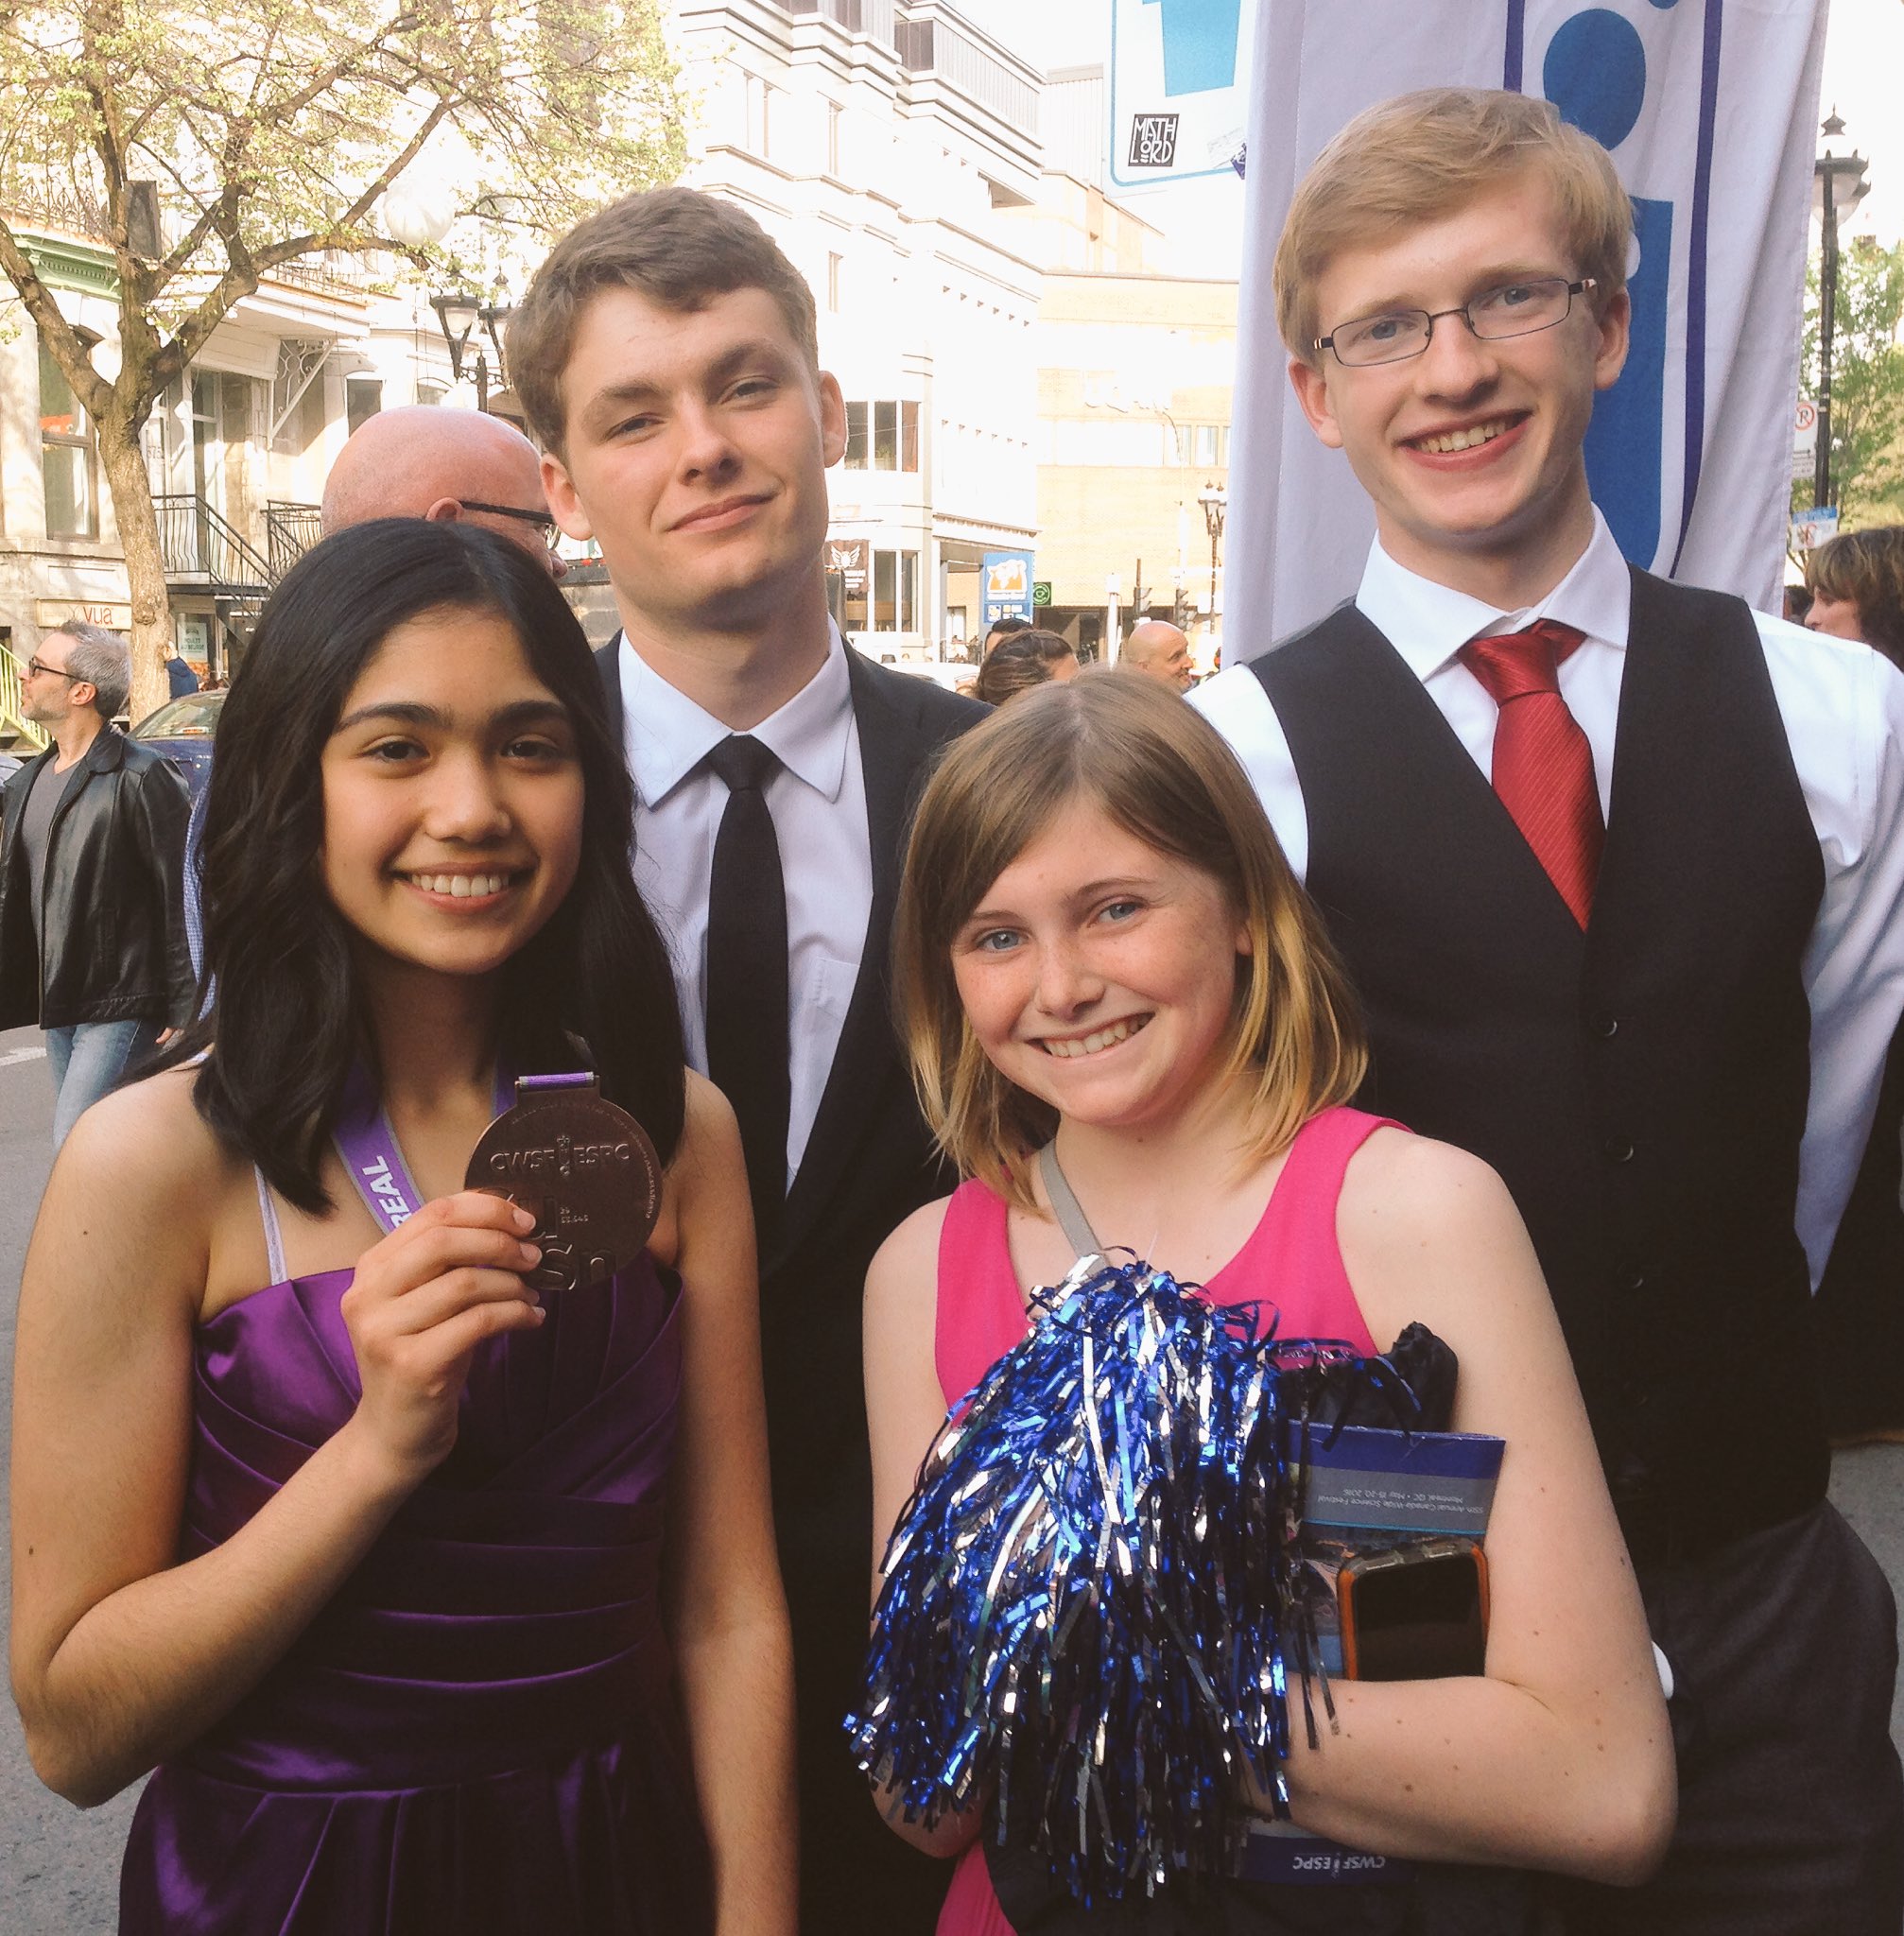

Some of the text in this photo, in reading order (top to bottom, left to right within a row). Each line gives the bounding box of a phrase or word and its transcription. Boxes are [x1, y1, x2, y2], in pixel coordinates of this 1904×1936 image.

[1133, 117, 1177, 141] MATH
[1129, 140, 1173, 164] LORD
[82, 606, 113, 625] vua
[490, 1142, 631, 1174] CWSF ESPC
[1292, 1856, 1386, 1871] CWSF ESPC
